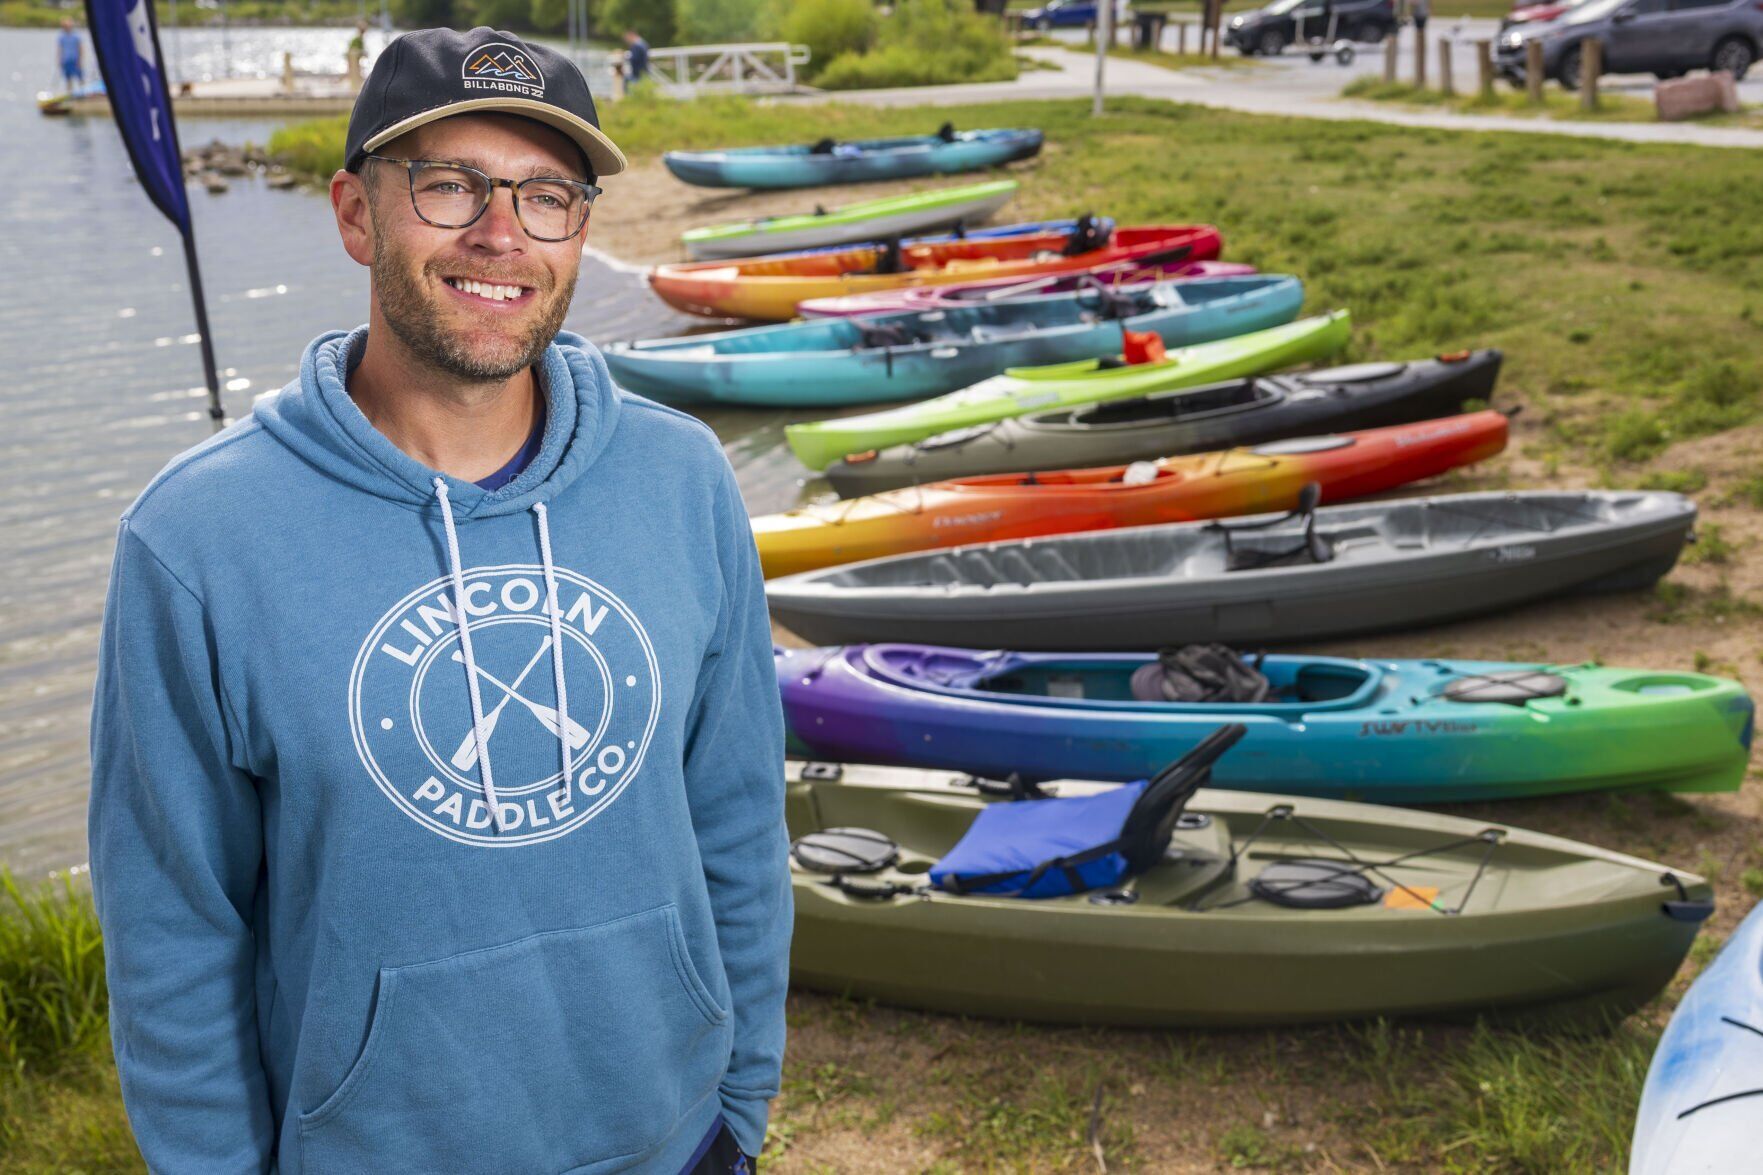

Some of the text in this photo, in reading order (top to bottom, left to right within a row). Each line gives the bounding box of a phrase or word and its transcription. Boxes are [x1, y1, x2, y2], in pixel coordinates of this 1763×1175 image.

[463, 80, 530, 95] BILLABONG
[412, 740, 636, 831] PADDLE CO.
